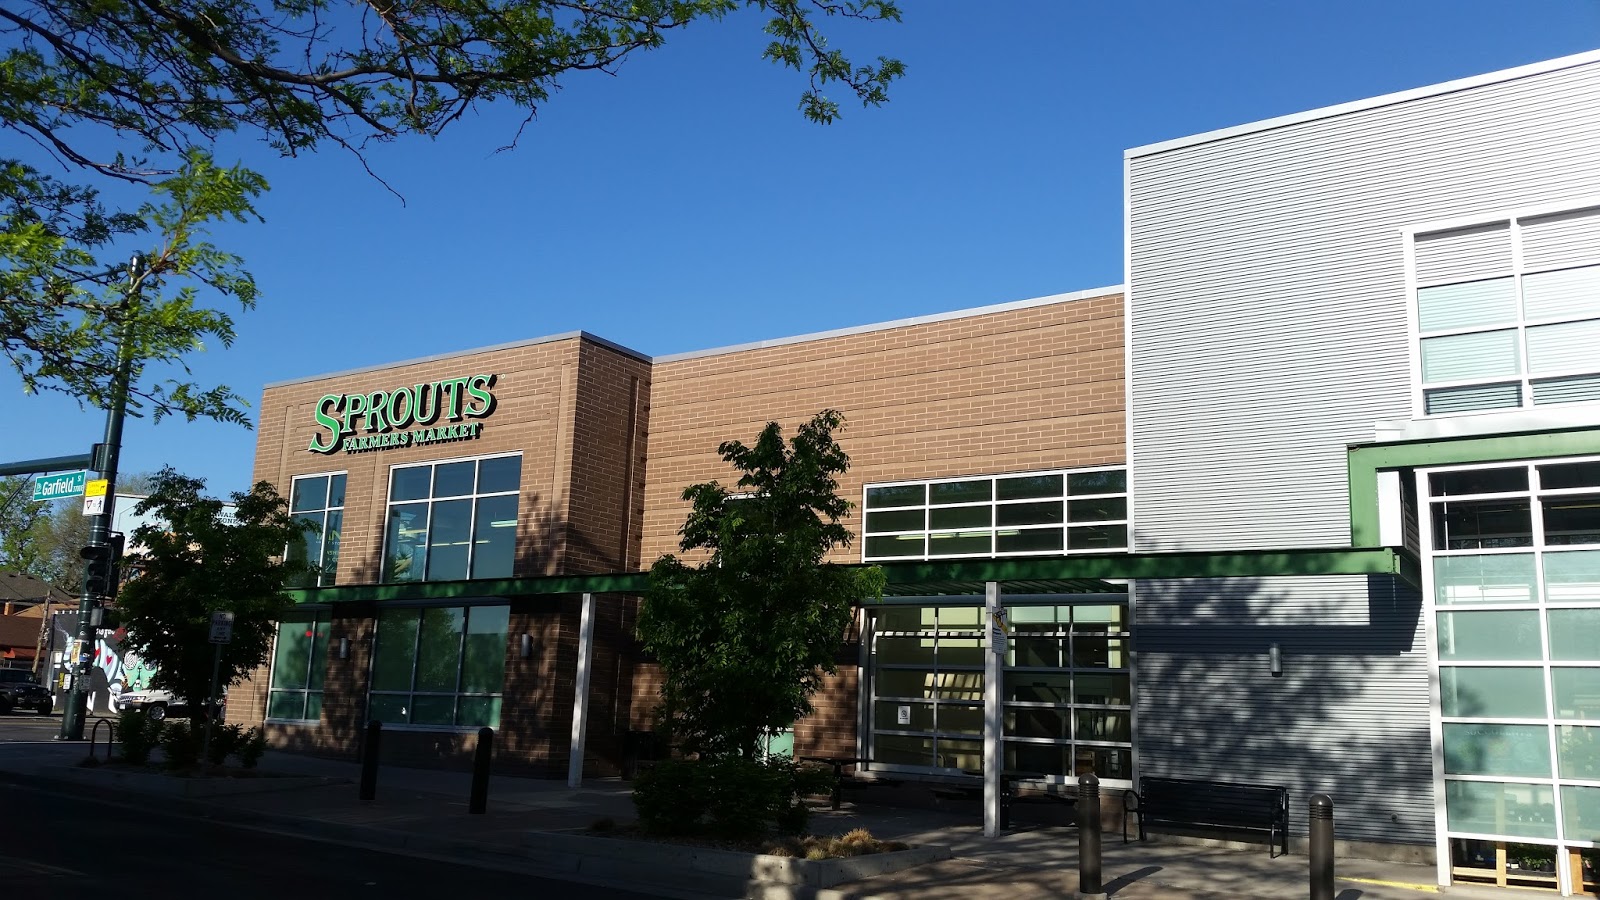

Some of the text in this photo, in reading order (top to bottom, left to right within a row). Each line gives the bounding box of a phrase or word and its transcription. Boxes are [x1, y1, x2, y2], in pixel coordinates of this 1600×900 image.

[308, 374, 497, 453] SPROUTS
[342, 421, 482, 453] FARMERS MARKET
[42, 477, 74, 496] Garfield
